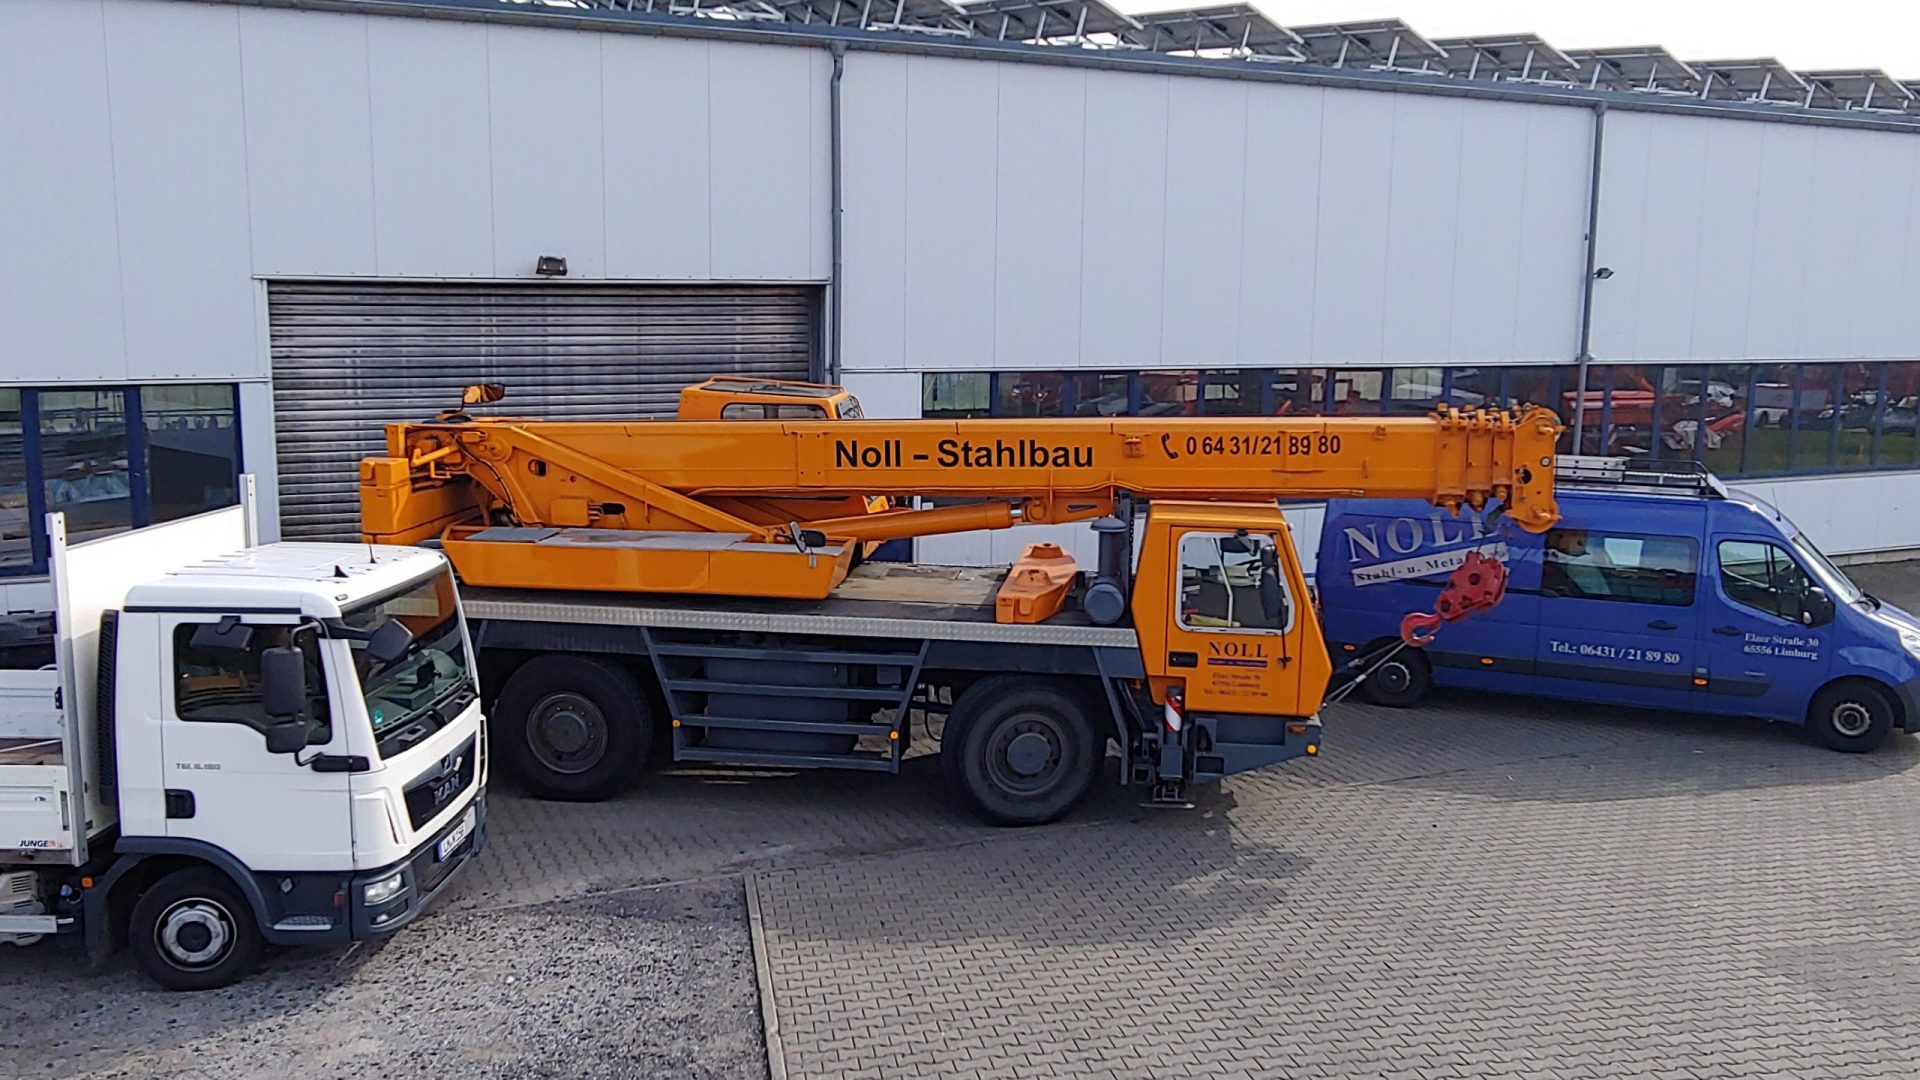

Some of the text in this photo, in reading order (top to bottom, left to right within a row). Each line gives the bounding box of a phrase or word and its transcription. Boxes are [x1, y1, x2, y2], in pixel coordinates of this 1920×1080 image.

[835, 439, 902, 468] Noll
[936, 438, 1093, 468] Stahlbau
[1186, 435, 1341, 456] 0 64 31/21 89 80
[1343, 511, 1499, 563] NOLL
[1208, 641, 1268, 658] NOLL
[1580, 643, 1616, 658] 06431
[1627, 648, 1642, 660] 21
[1645, 650, 1661, 662] 89
[1663, 652, 1681, 664] 80
[1774, 646, 1819, 661] Limburg
[433, 772, 461, 807] MAN
